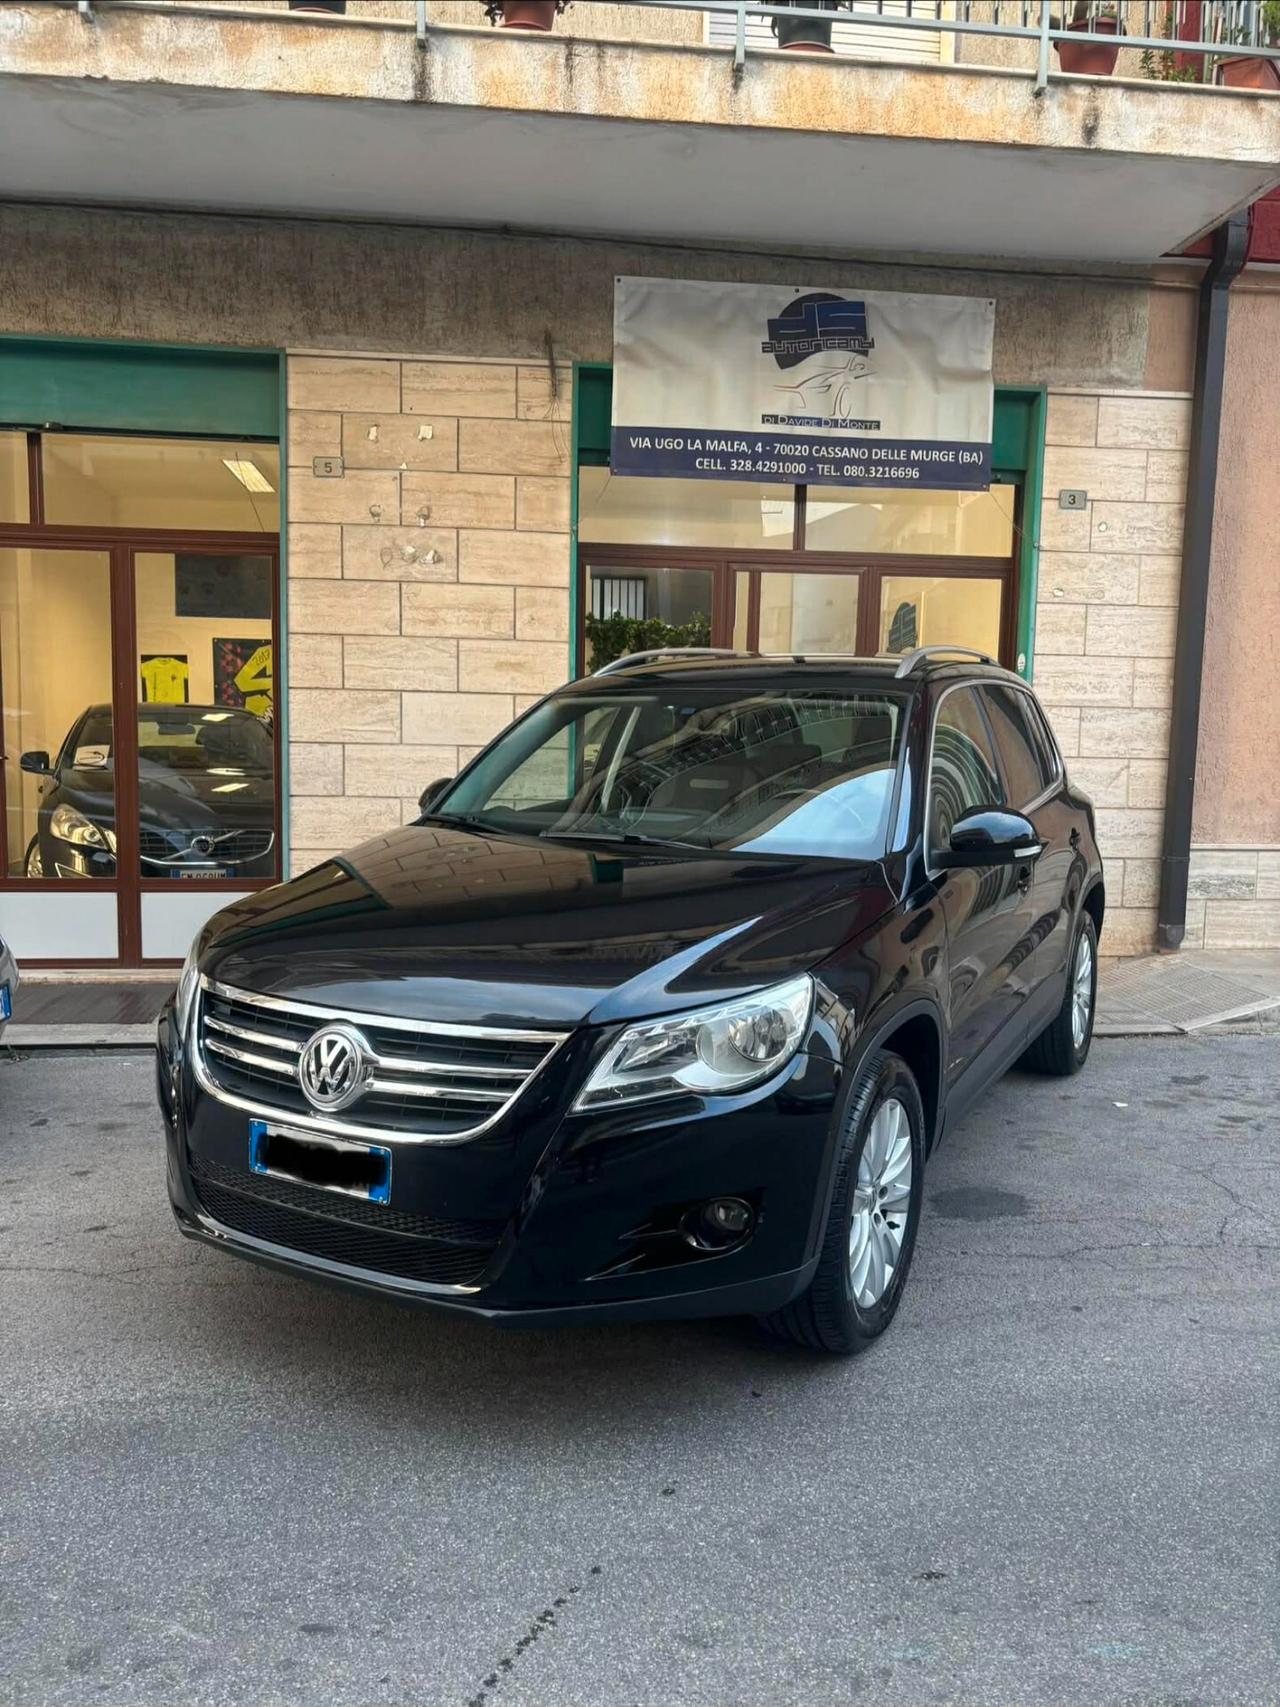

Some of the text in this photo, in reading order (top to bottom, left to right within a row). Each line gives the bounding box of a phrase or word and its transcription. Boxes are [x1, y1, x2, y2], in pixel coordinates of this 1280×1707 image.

[778, 415, 818, 427] DAVIDE
[838, 418, 879, 430] MONTE
[629, 436, 652, 449] VIA
[655, 437, 684, 450] UGO
[687, 439, 703, 451] LA
[705, 440, 752, 455] MALFA,
[754, 441, 763, 454] 4
[773, 443, 810, 457] 70020
[812, 445, 869, 460] CASSANO
[872, 448, 907, 461] DELLE
[910, 450, 956, 463] MURGE
[959, 450, 984, 466] (BA)
[324, 462, 333, 474] 5
[695, 457, 727, 471] CELL.
[730, 459, 808, 476] 328.4291000
[817, 464, 841, 477] TEL.
[843, 464, 920, 480] 080.3216696
[1068, 494, 1077, 505] 3
